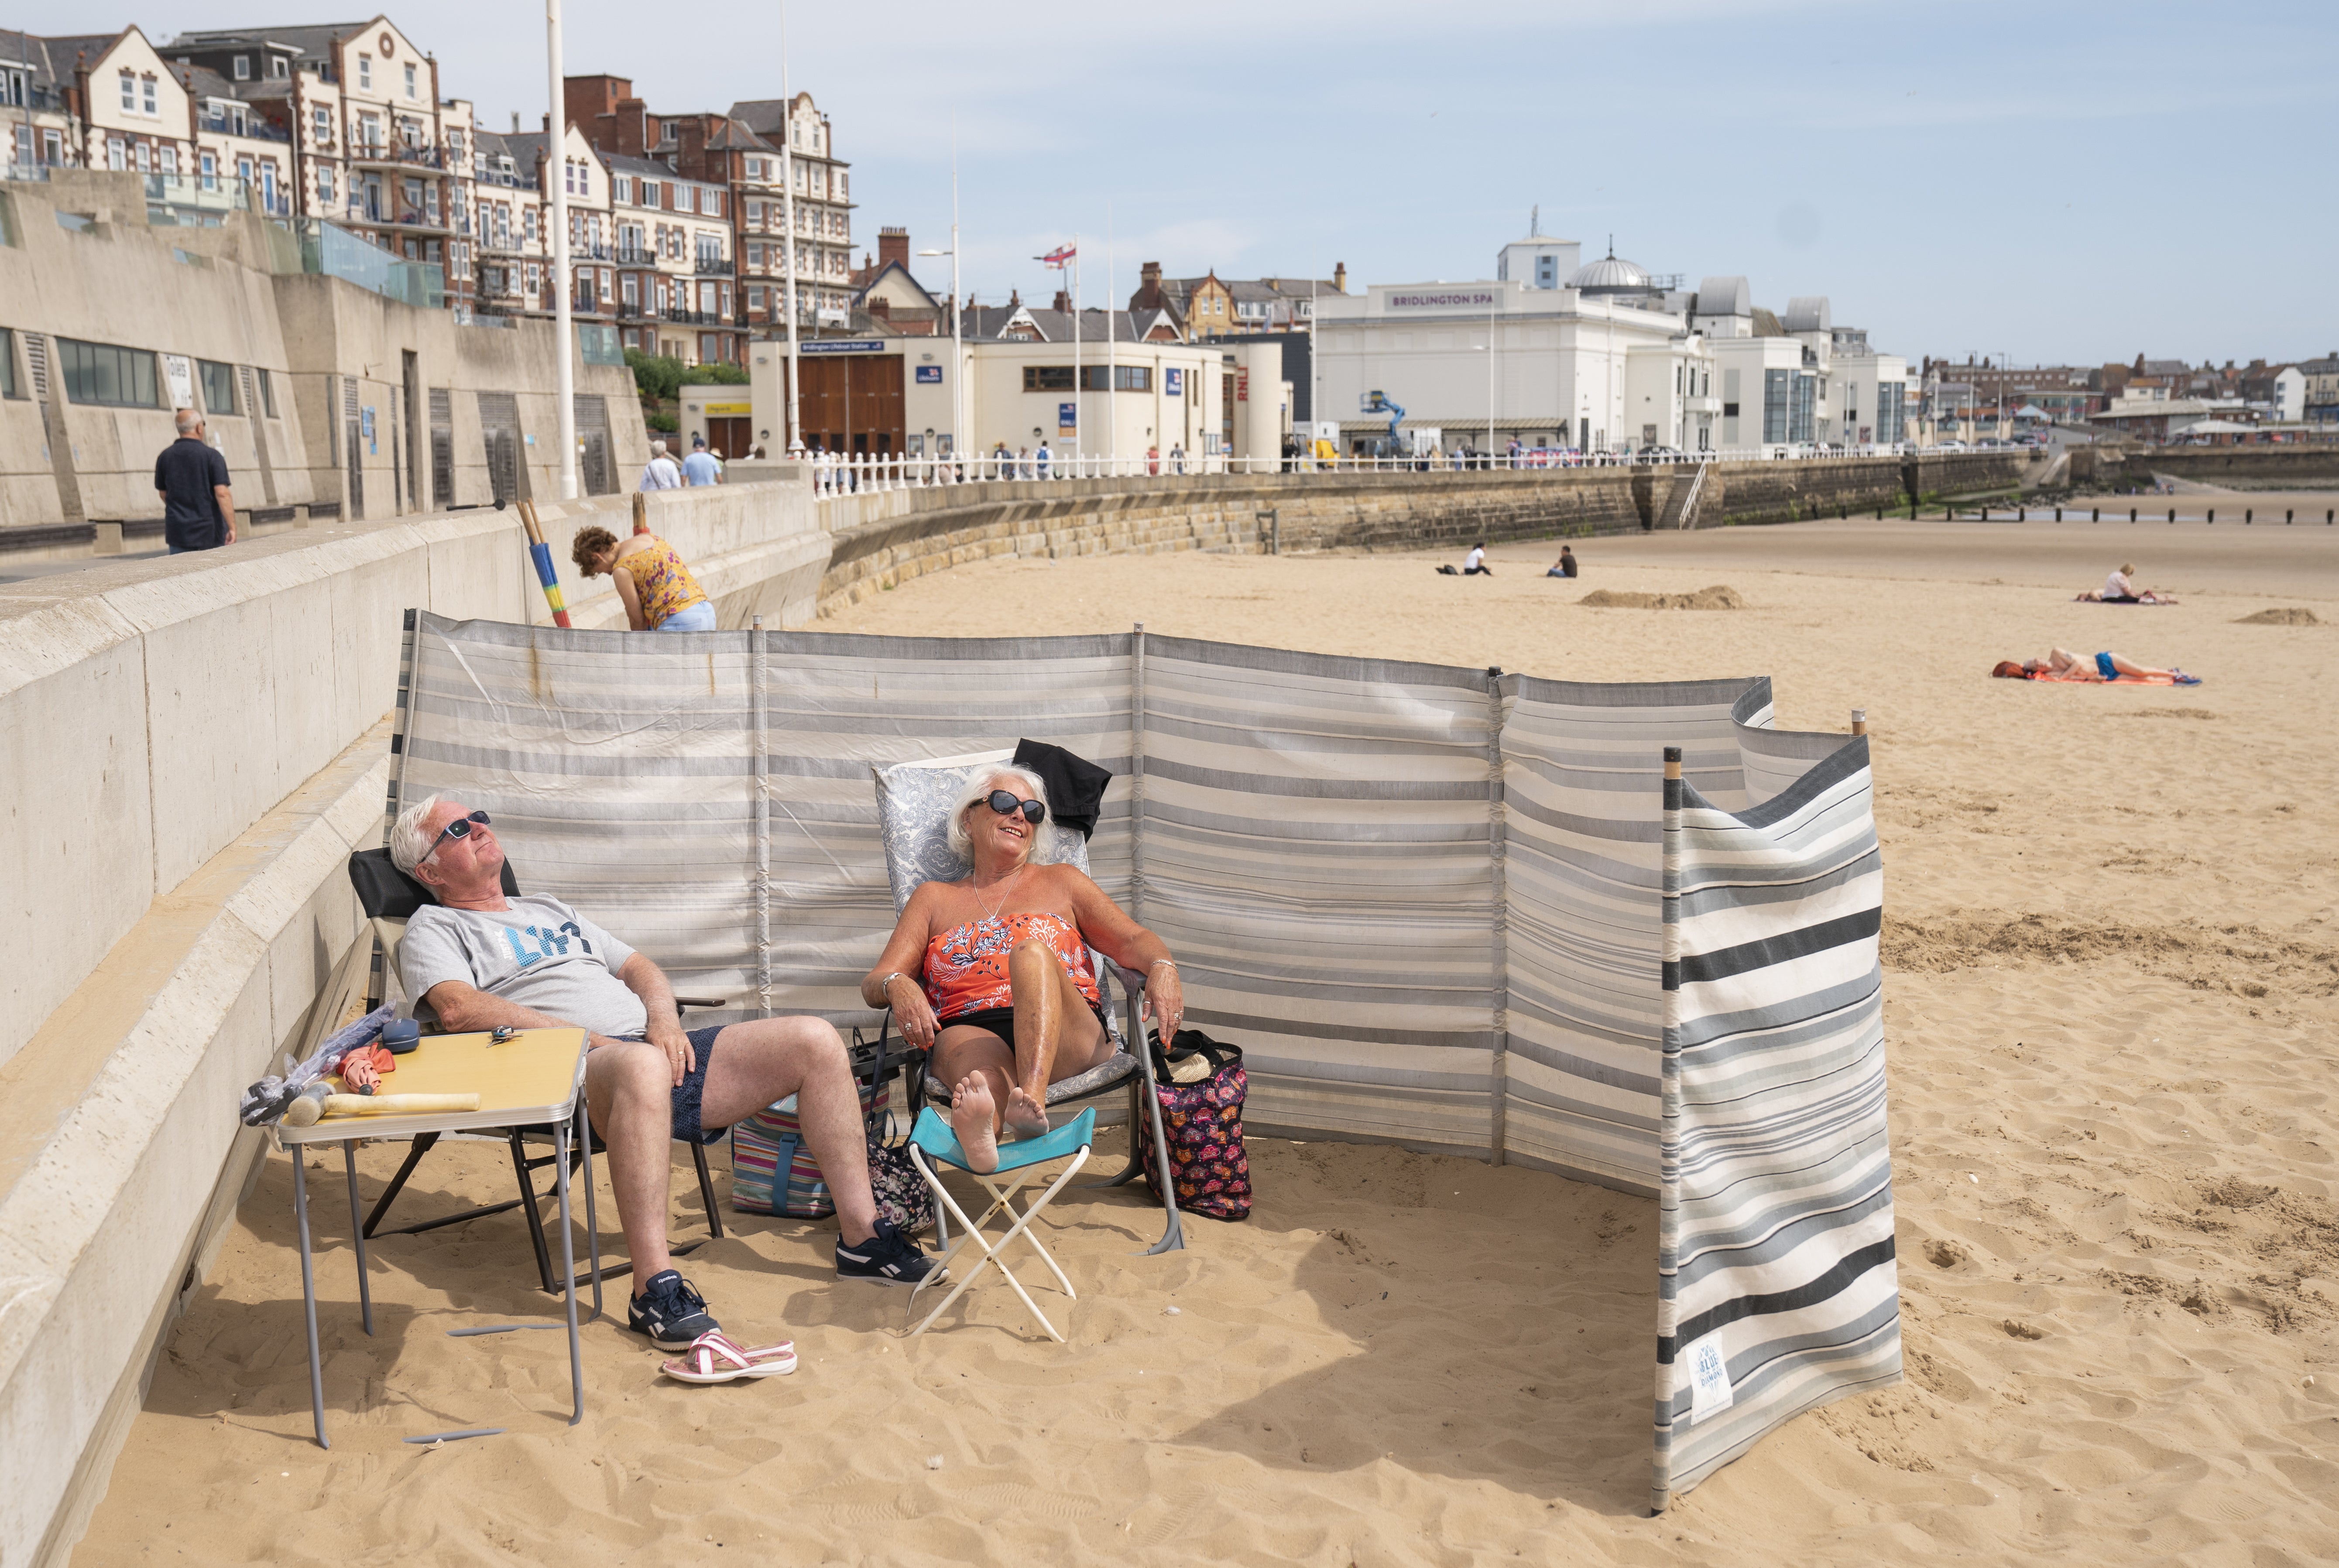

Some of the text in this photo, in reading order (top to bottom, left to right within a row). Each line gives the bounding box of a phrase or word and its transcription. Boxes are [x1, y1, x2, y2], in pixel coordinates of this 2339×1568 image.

[1393, 294, 1492, 306] BRIDLINGTON SPA
[803, 343, 829, 352] Bridlington
[1238, 366, 1248, 401] RNLI
[658, 1274, 677, 1284] Reebok
[648, 1306, 662, 1320] Reebok
[1700, 1354, 1718, 1373] BLUE
